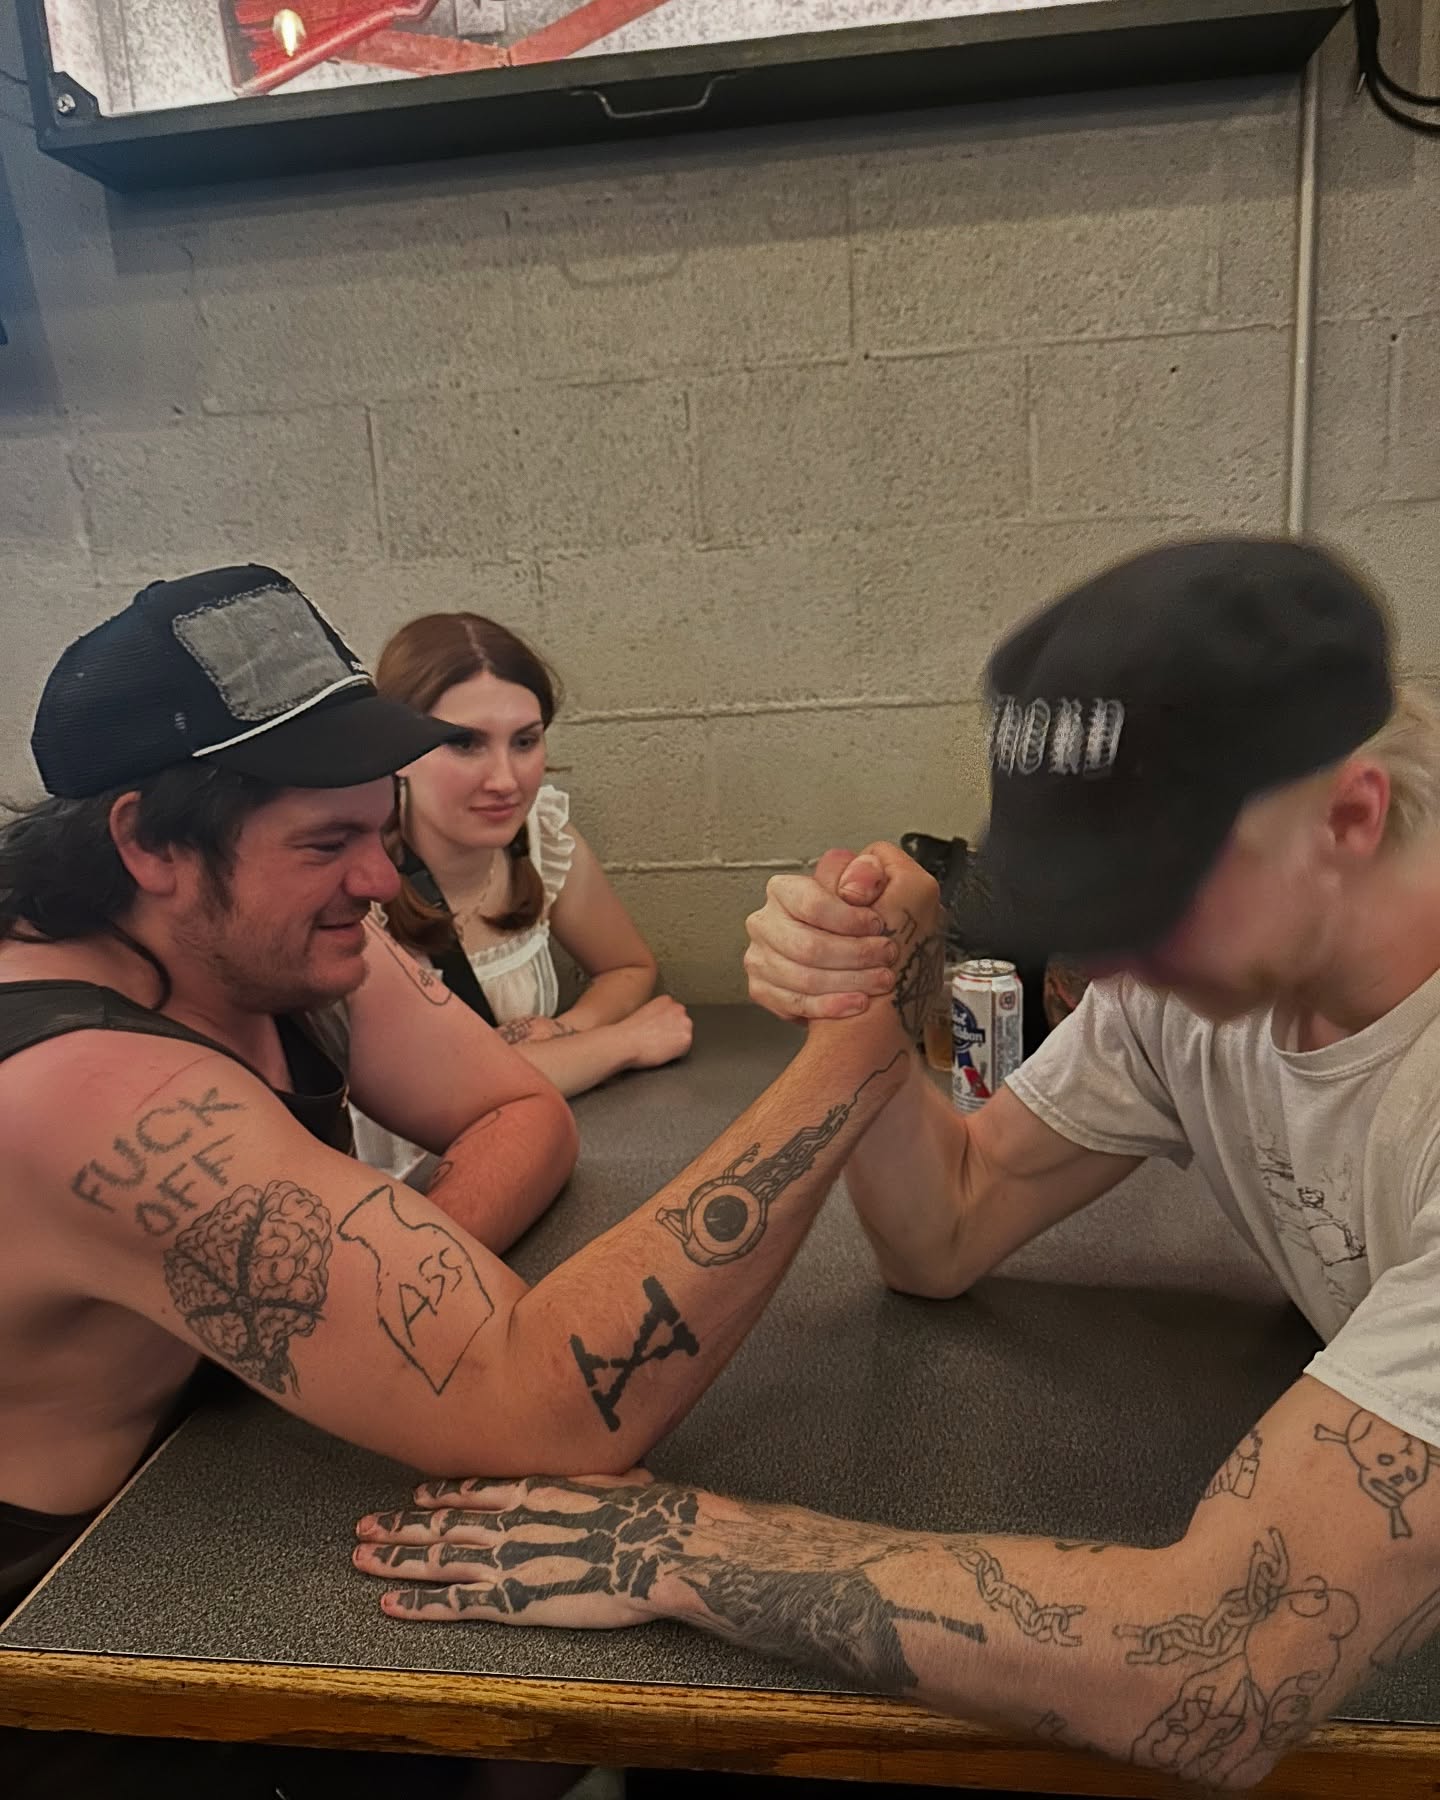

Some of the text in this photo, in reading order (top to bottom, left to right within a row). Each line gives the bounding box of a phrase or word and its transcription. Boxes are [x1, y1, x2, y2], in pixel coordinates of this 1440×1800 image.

[70, 1087, 246, 1214] FUCK
[134, 1133, 236, 1236] OFF
[398, 1247, 463, 1347] ASS
